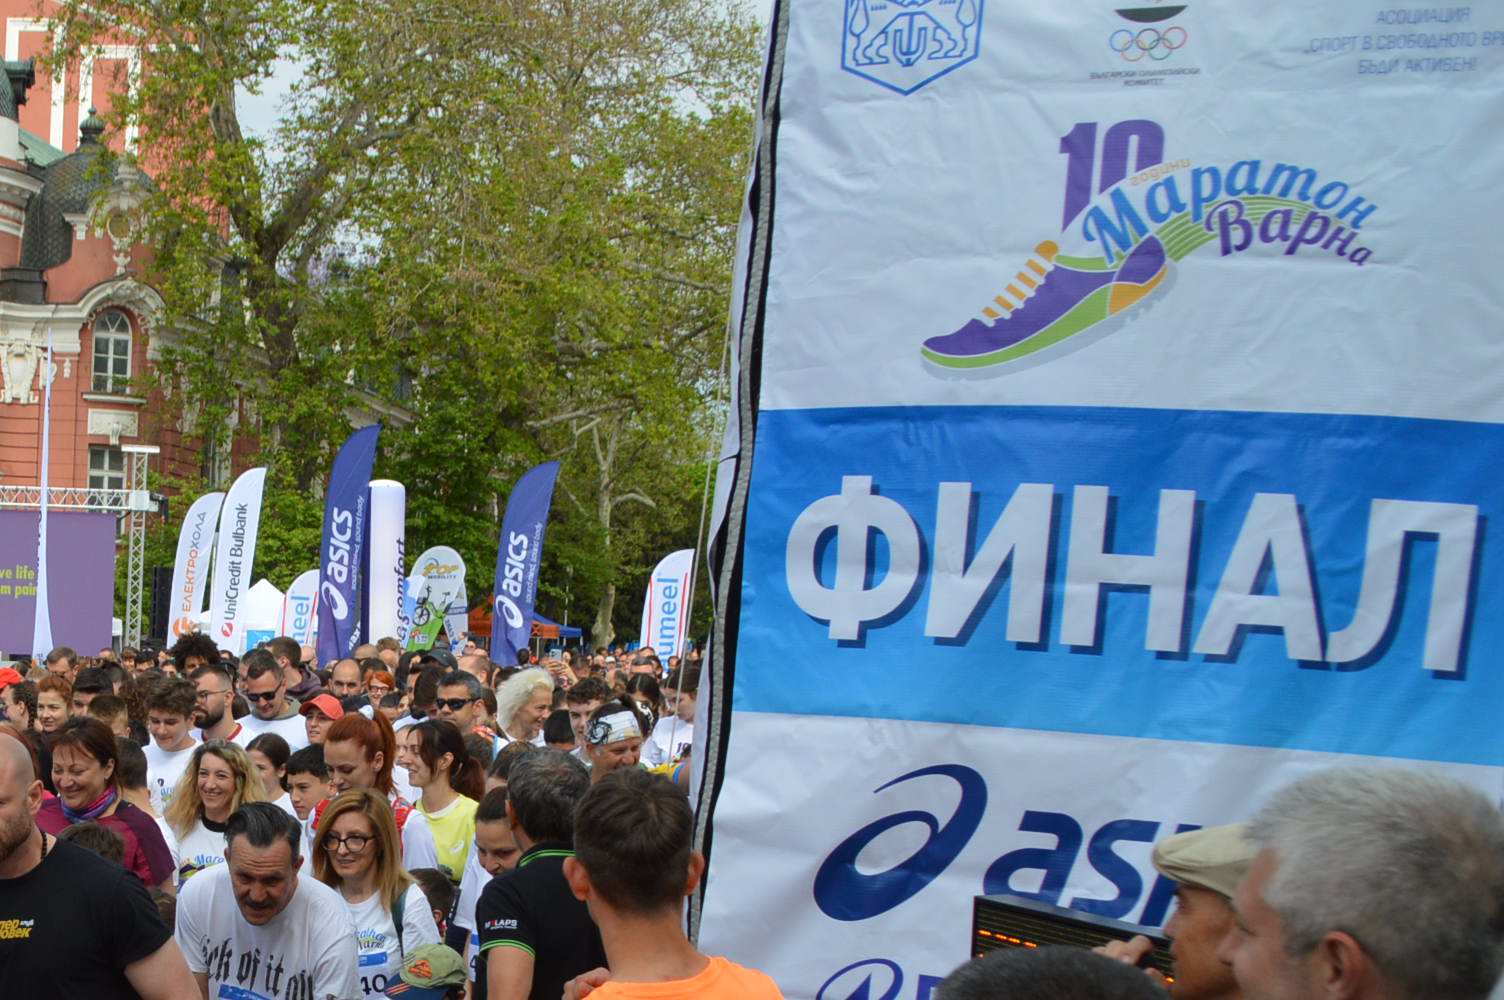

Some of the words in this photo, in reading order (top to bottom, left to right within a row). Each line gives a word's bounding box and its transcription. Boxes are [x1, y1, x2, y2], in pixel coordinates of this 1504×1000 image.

[1059, 119, 1165, 234] 10
[1082, 158, 1378, 267] Маратон
[1205, 199, 1374, 267] Варна
[229, 503, 249, 558] Bulbank
[15, 565, 36, 580] life
[224, 561, 242, 621] UniCredit
[785, 475, 1486, 681] ФИНАЛ
